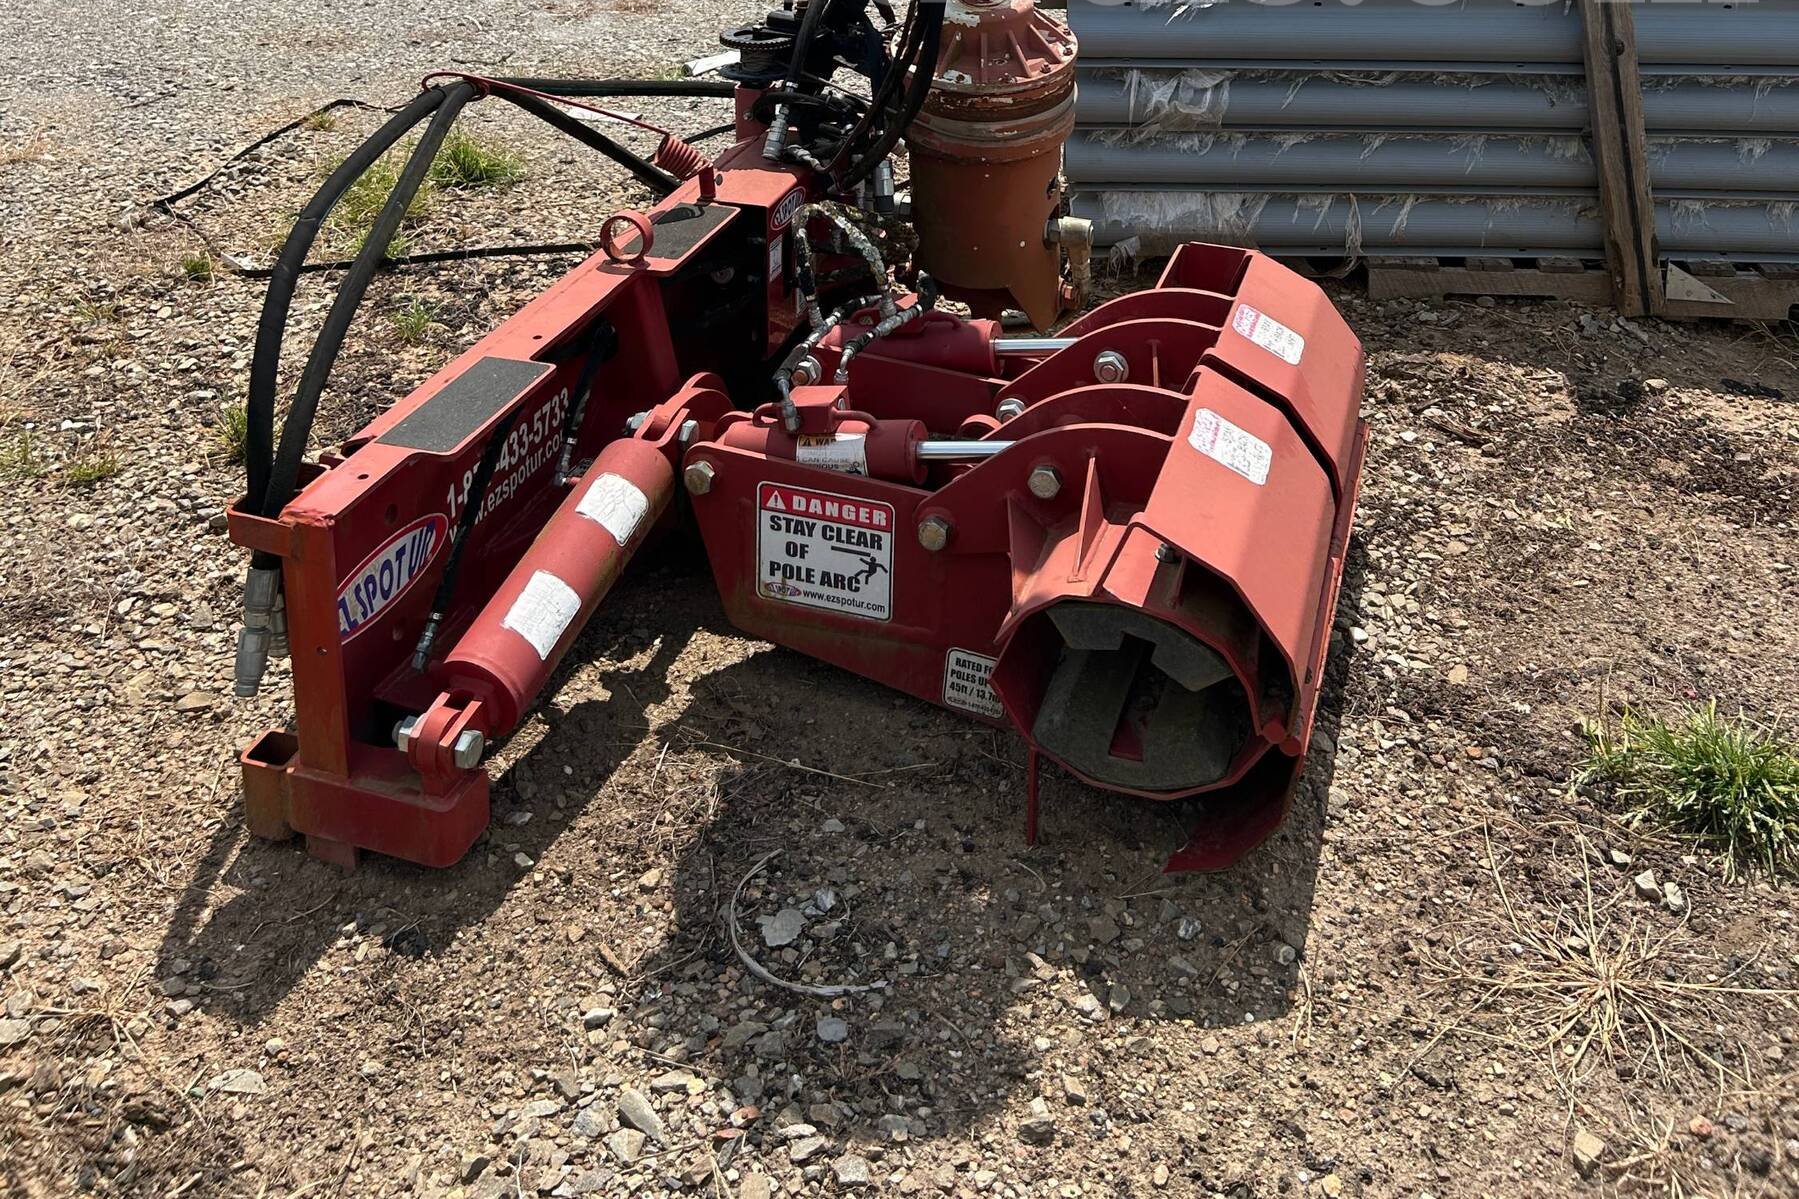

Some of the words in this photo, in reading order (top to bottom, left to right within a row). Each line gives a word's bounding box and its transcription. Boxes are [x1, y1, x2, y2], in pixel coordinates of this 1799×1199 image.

[447, 387, 569, 519] 1-8-433-5733
[792, 495, 886, 526] DANGER
[770, 515, 817, 538] STAY
[821, 524, 882, 551] CLEAR
[785, 541, 809, 559] OF
[354, 543, 407, 620] SPOT
[769, 561, 815, 584] POLE
[819, 570, 861, 593] ARC
[803, 588, 886, 613] www.ezspotur.com
[950, 668, 977, 684] POLES
[955, 657, 983, 673] RATED
[949, 681, 968, 695] 45ft
